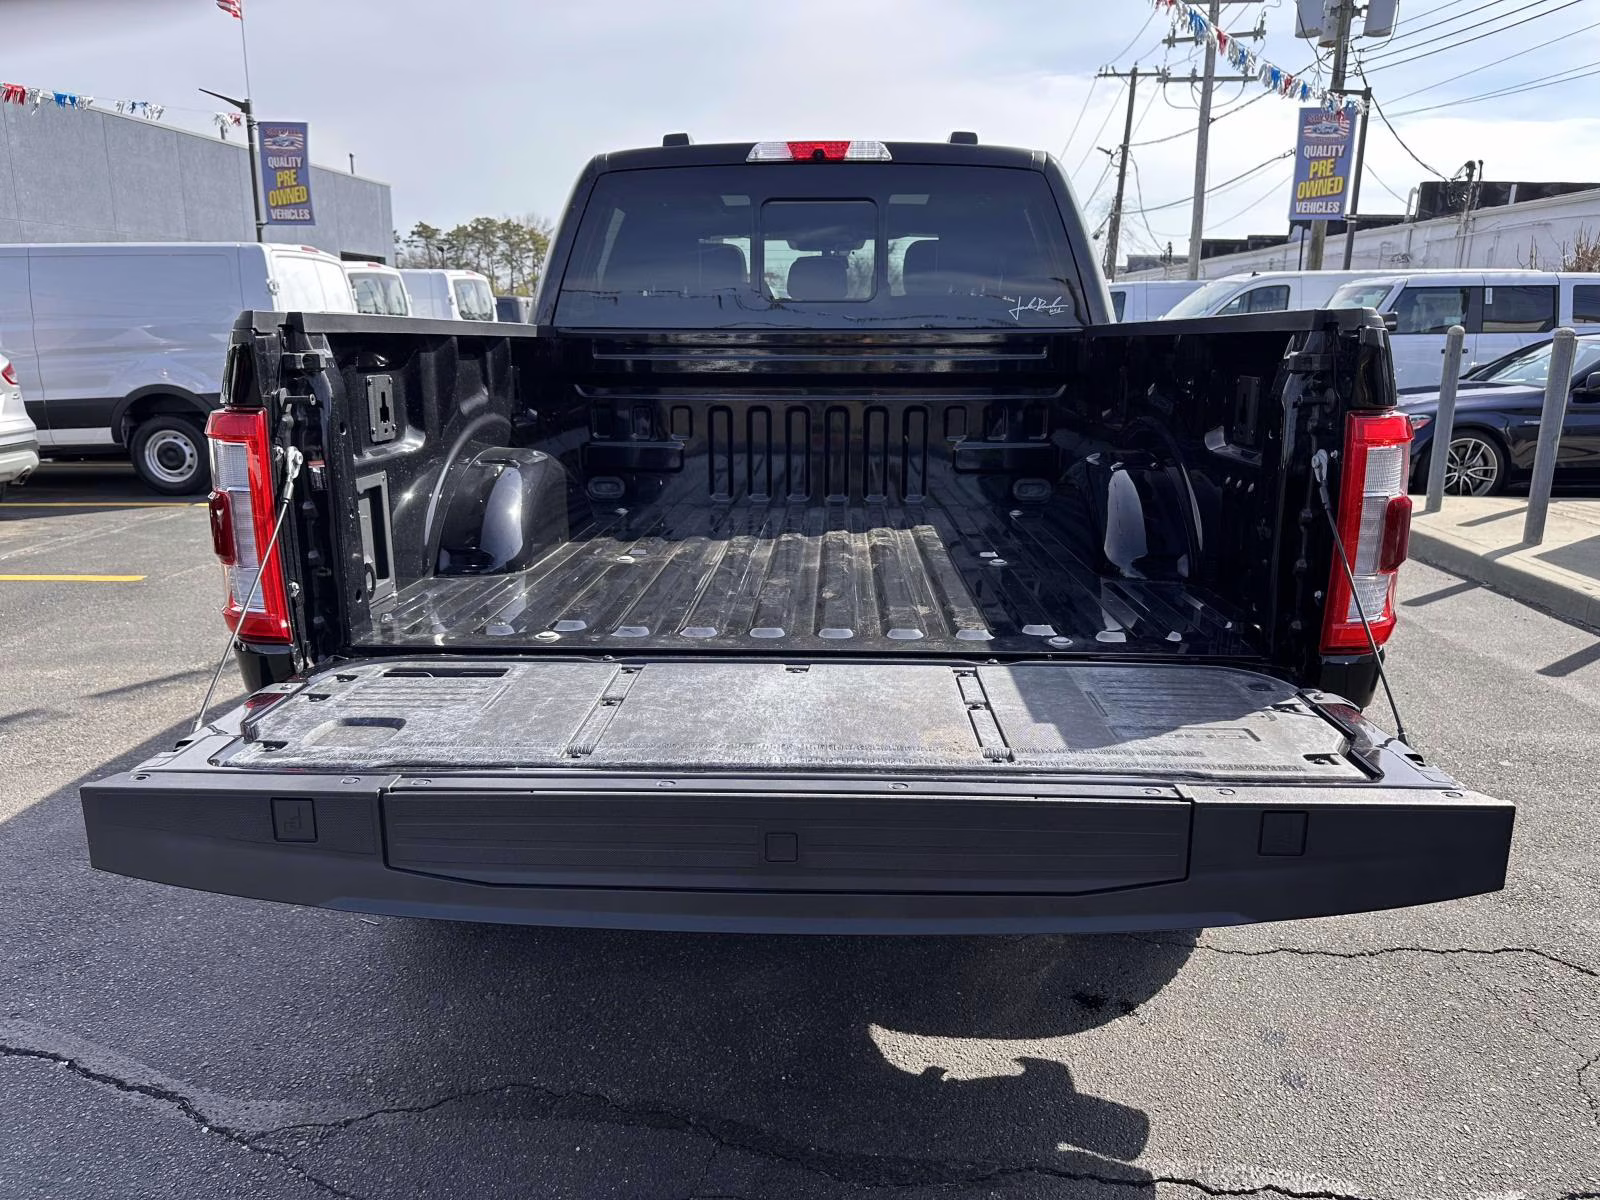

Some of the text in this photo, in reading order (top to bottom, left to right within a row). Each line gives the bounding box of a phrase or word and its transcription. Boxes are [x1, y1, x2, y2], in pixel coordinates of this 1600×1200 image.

[1303, 145, 1344, 158] QUALITY
[267, 157, 302, 168] QUALITY
[1309, 158, 1335, 179] PRE
[276, 169, 297, 187] PRE
[1297, 176, 1343, 199] OWNED
[269, 186, 307, 206] OWNED
[271, 209, 310, 219] VEHICLES
[1295, 202, 1339, 213] VEHICLES
